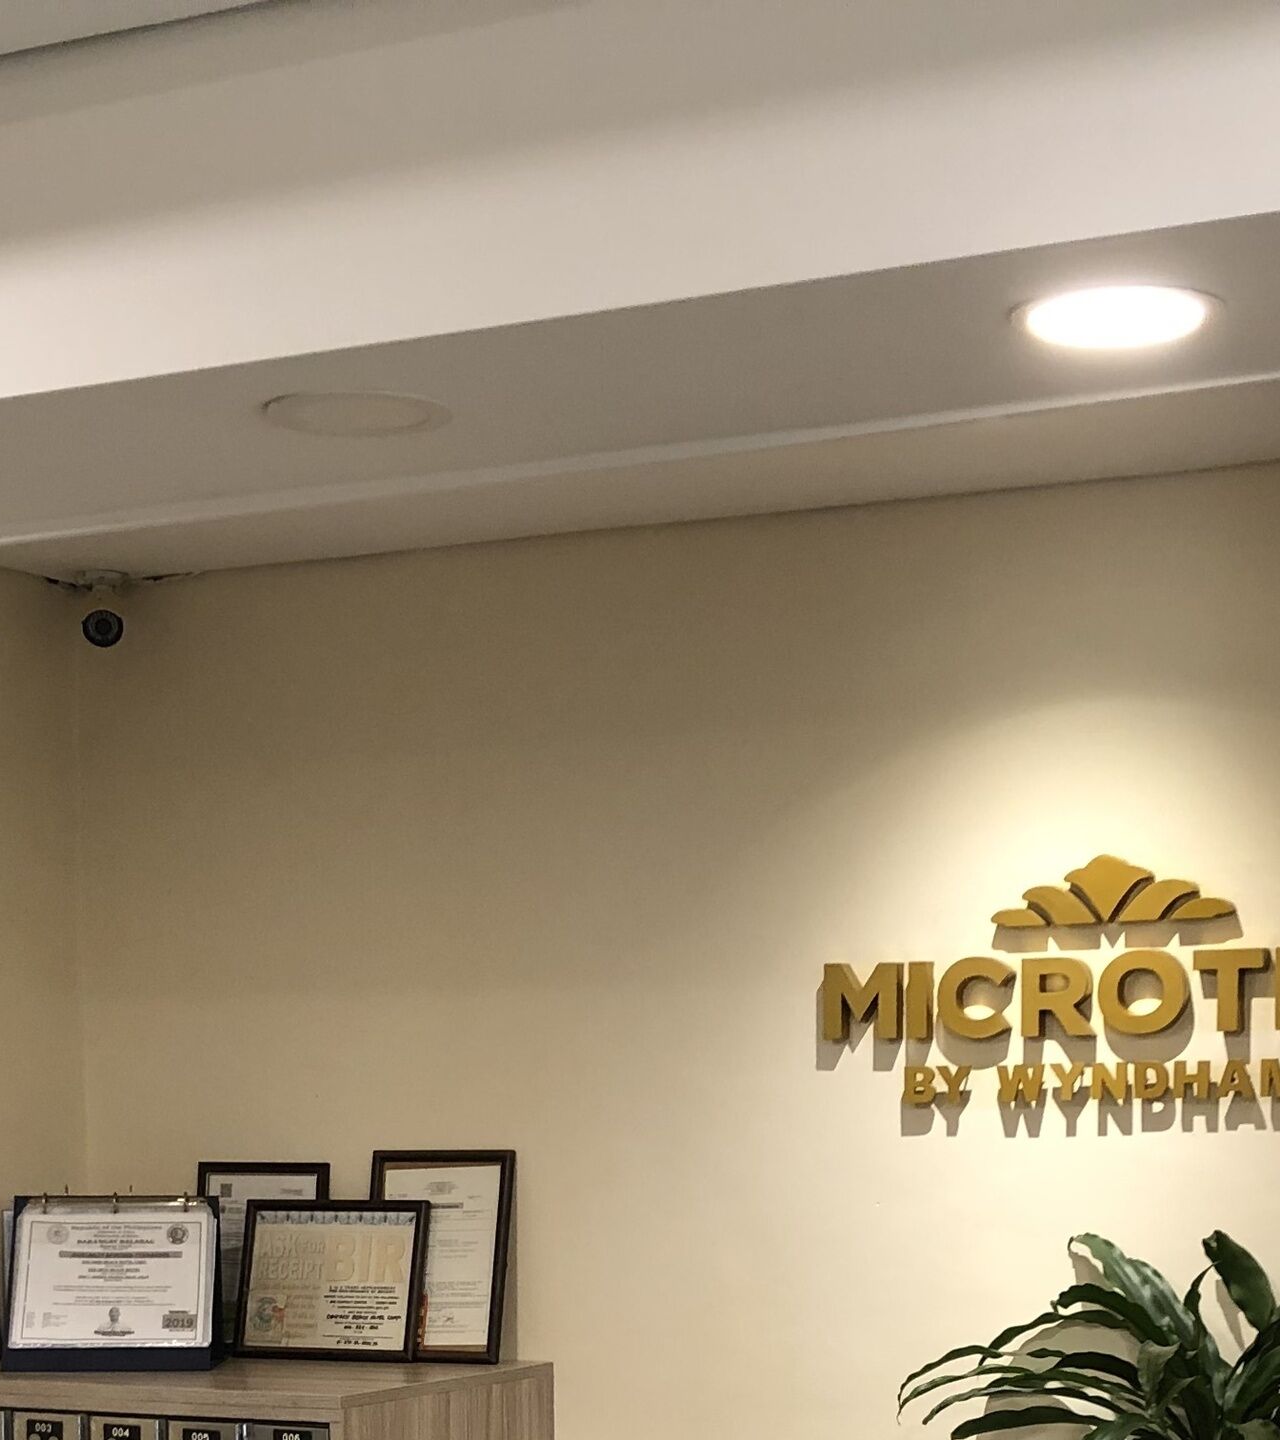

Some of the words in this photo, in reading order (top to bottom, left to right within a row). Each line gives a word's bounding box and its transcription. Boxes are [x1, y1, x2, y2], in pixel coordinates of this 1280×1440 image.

[902, 1064, 973, 1105] BY
[35, 1423, 52, 1433] 003
[112, 1427, 130, 1437] 004
